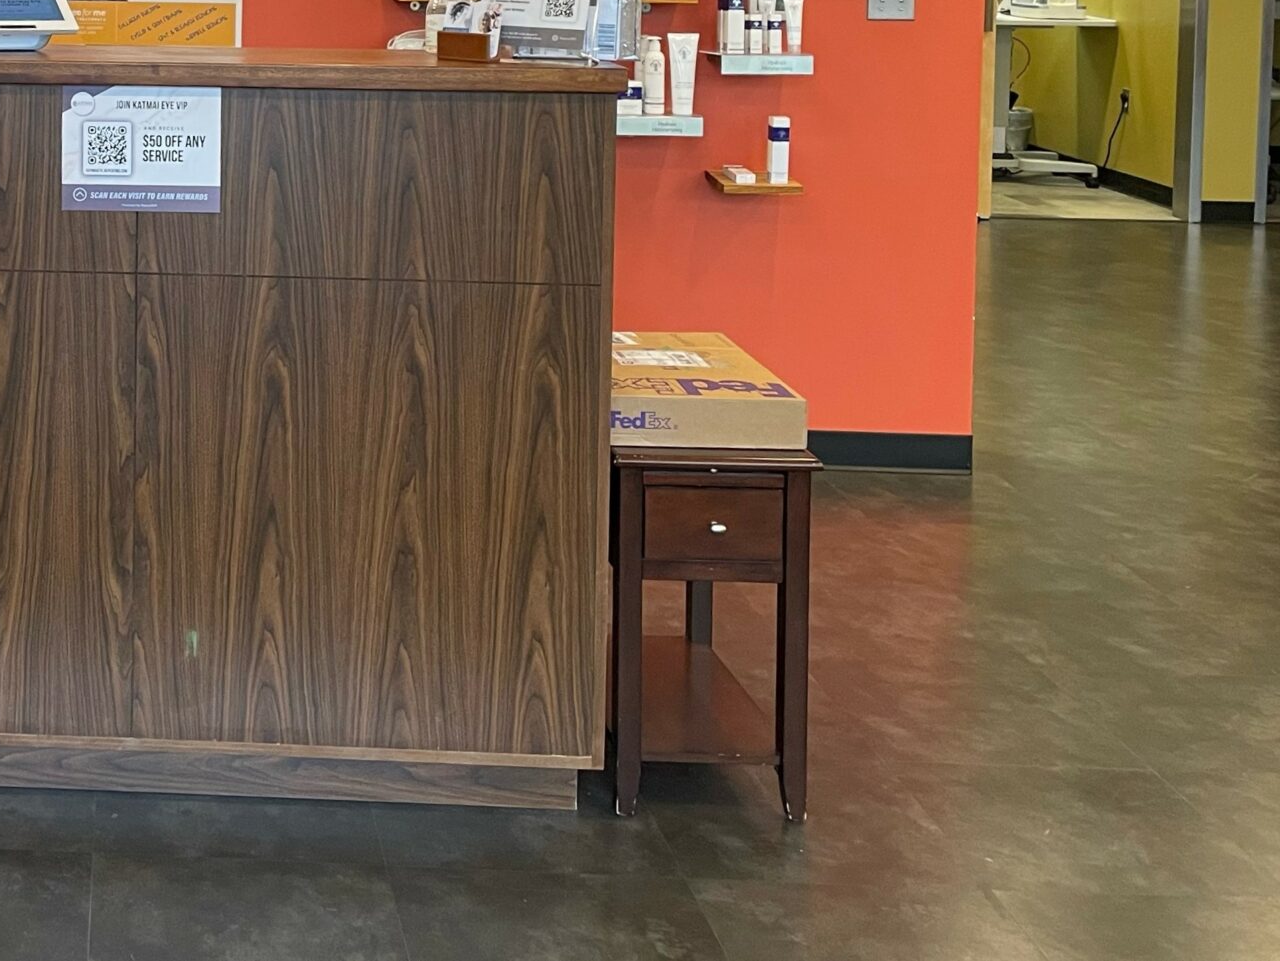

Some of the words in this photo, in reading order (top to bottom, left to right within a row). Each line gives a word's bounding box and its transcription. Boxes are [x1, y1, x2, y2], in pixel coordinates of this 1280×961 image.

[116, 100, 131, 109] JOIN
[132, 101, 159, 110] KATMAI
[161, 101, 175, 110] EYE
[177, 101, 188, 110] VIP
[143, 134, 163, 148] $50
[165, 135, 183, 148] OFF
[185, 136, 206, 148] ANY
[143, 150, 184, 163] SERVICE
[176, 193, 208, 201] REWARDS
[610, 411, 671, 429] FedEx
